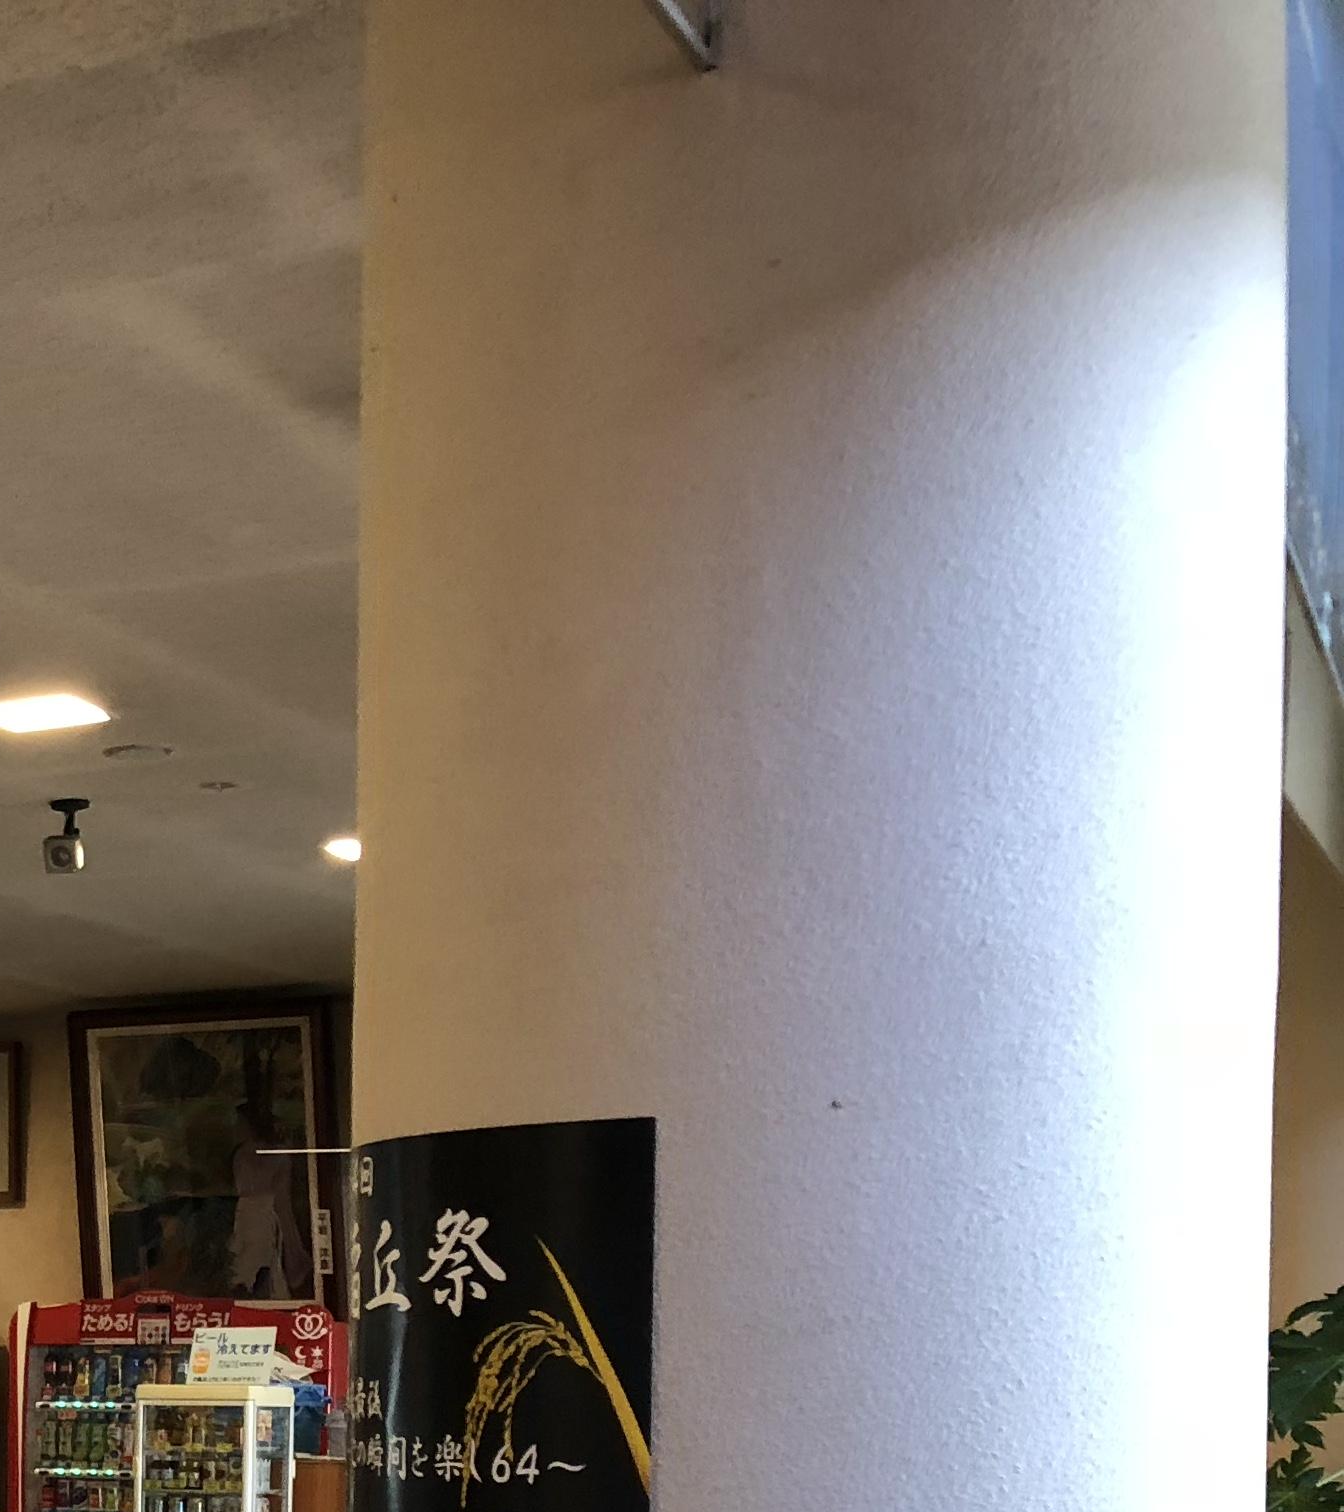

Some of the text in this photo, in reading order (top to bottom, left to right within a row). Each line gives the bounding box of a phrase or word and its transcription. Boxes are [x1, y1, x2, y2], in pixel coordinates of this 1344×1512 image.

[194, 1332, 228, 1344] ビール
[216, 1343, 272, 1356] 冷えてます
